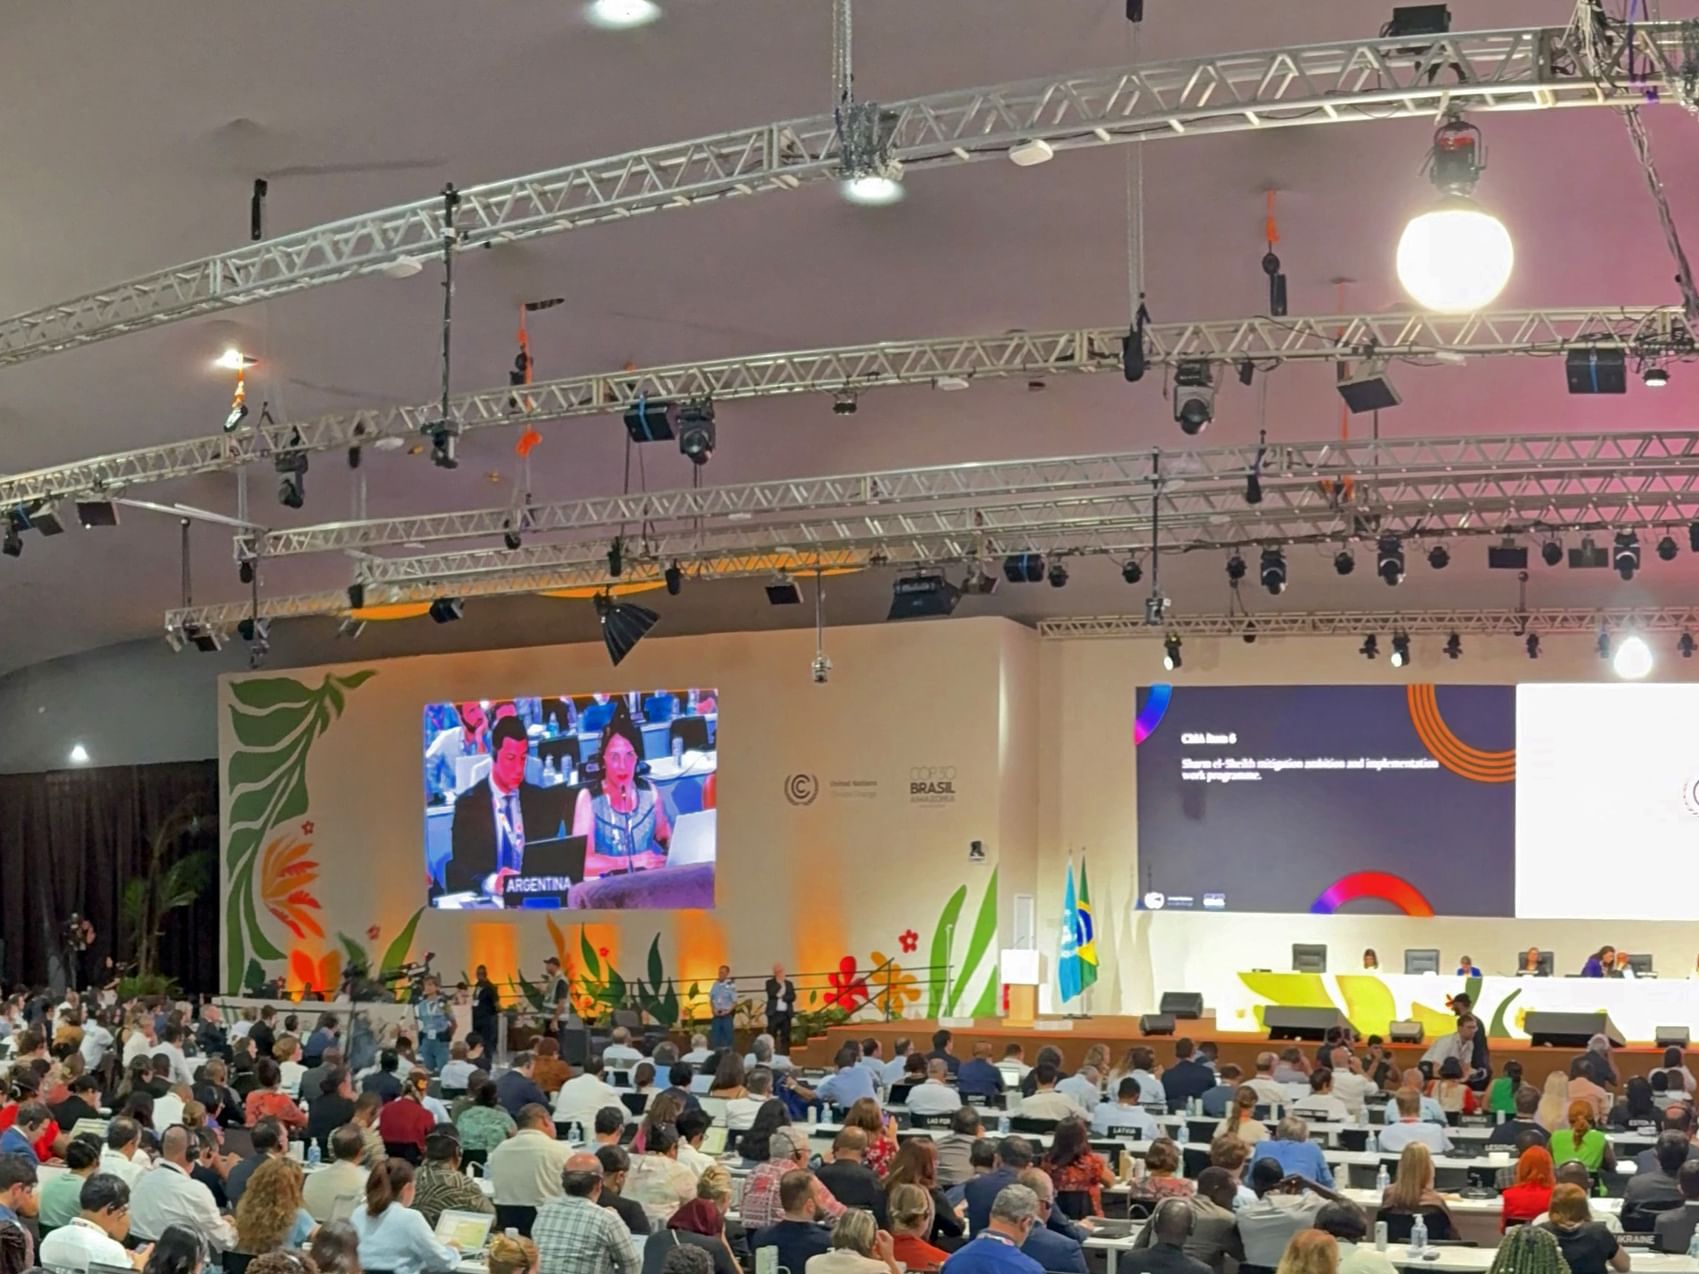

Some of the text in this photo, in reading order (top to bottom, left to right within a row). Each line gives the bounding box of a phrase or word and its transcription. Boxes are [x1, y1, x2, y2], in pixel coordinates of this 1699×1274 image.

[1257, 757, 1303, 771] mitigation
[1347, 757, 1365, 769] and
[1366, 757, 1440, 771] implementation
[910, 782, 956, 794] BRASIL
[506, 876, 571, 893] ARGENTINA
